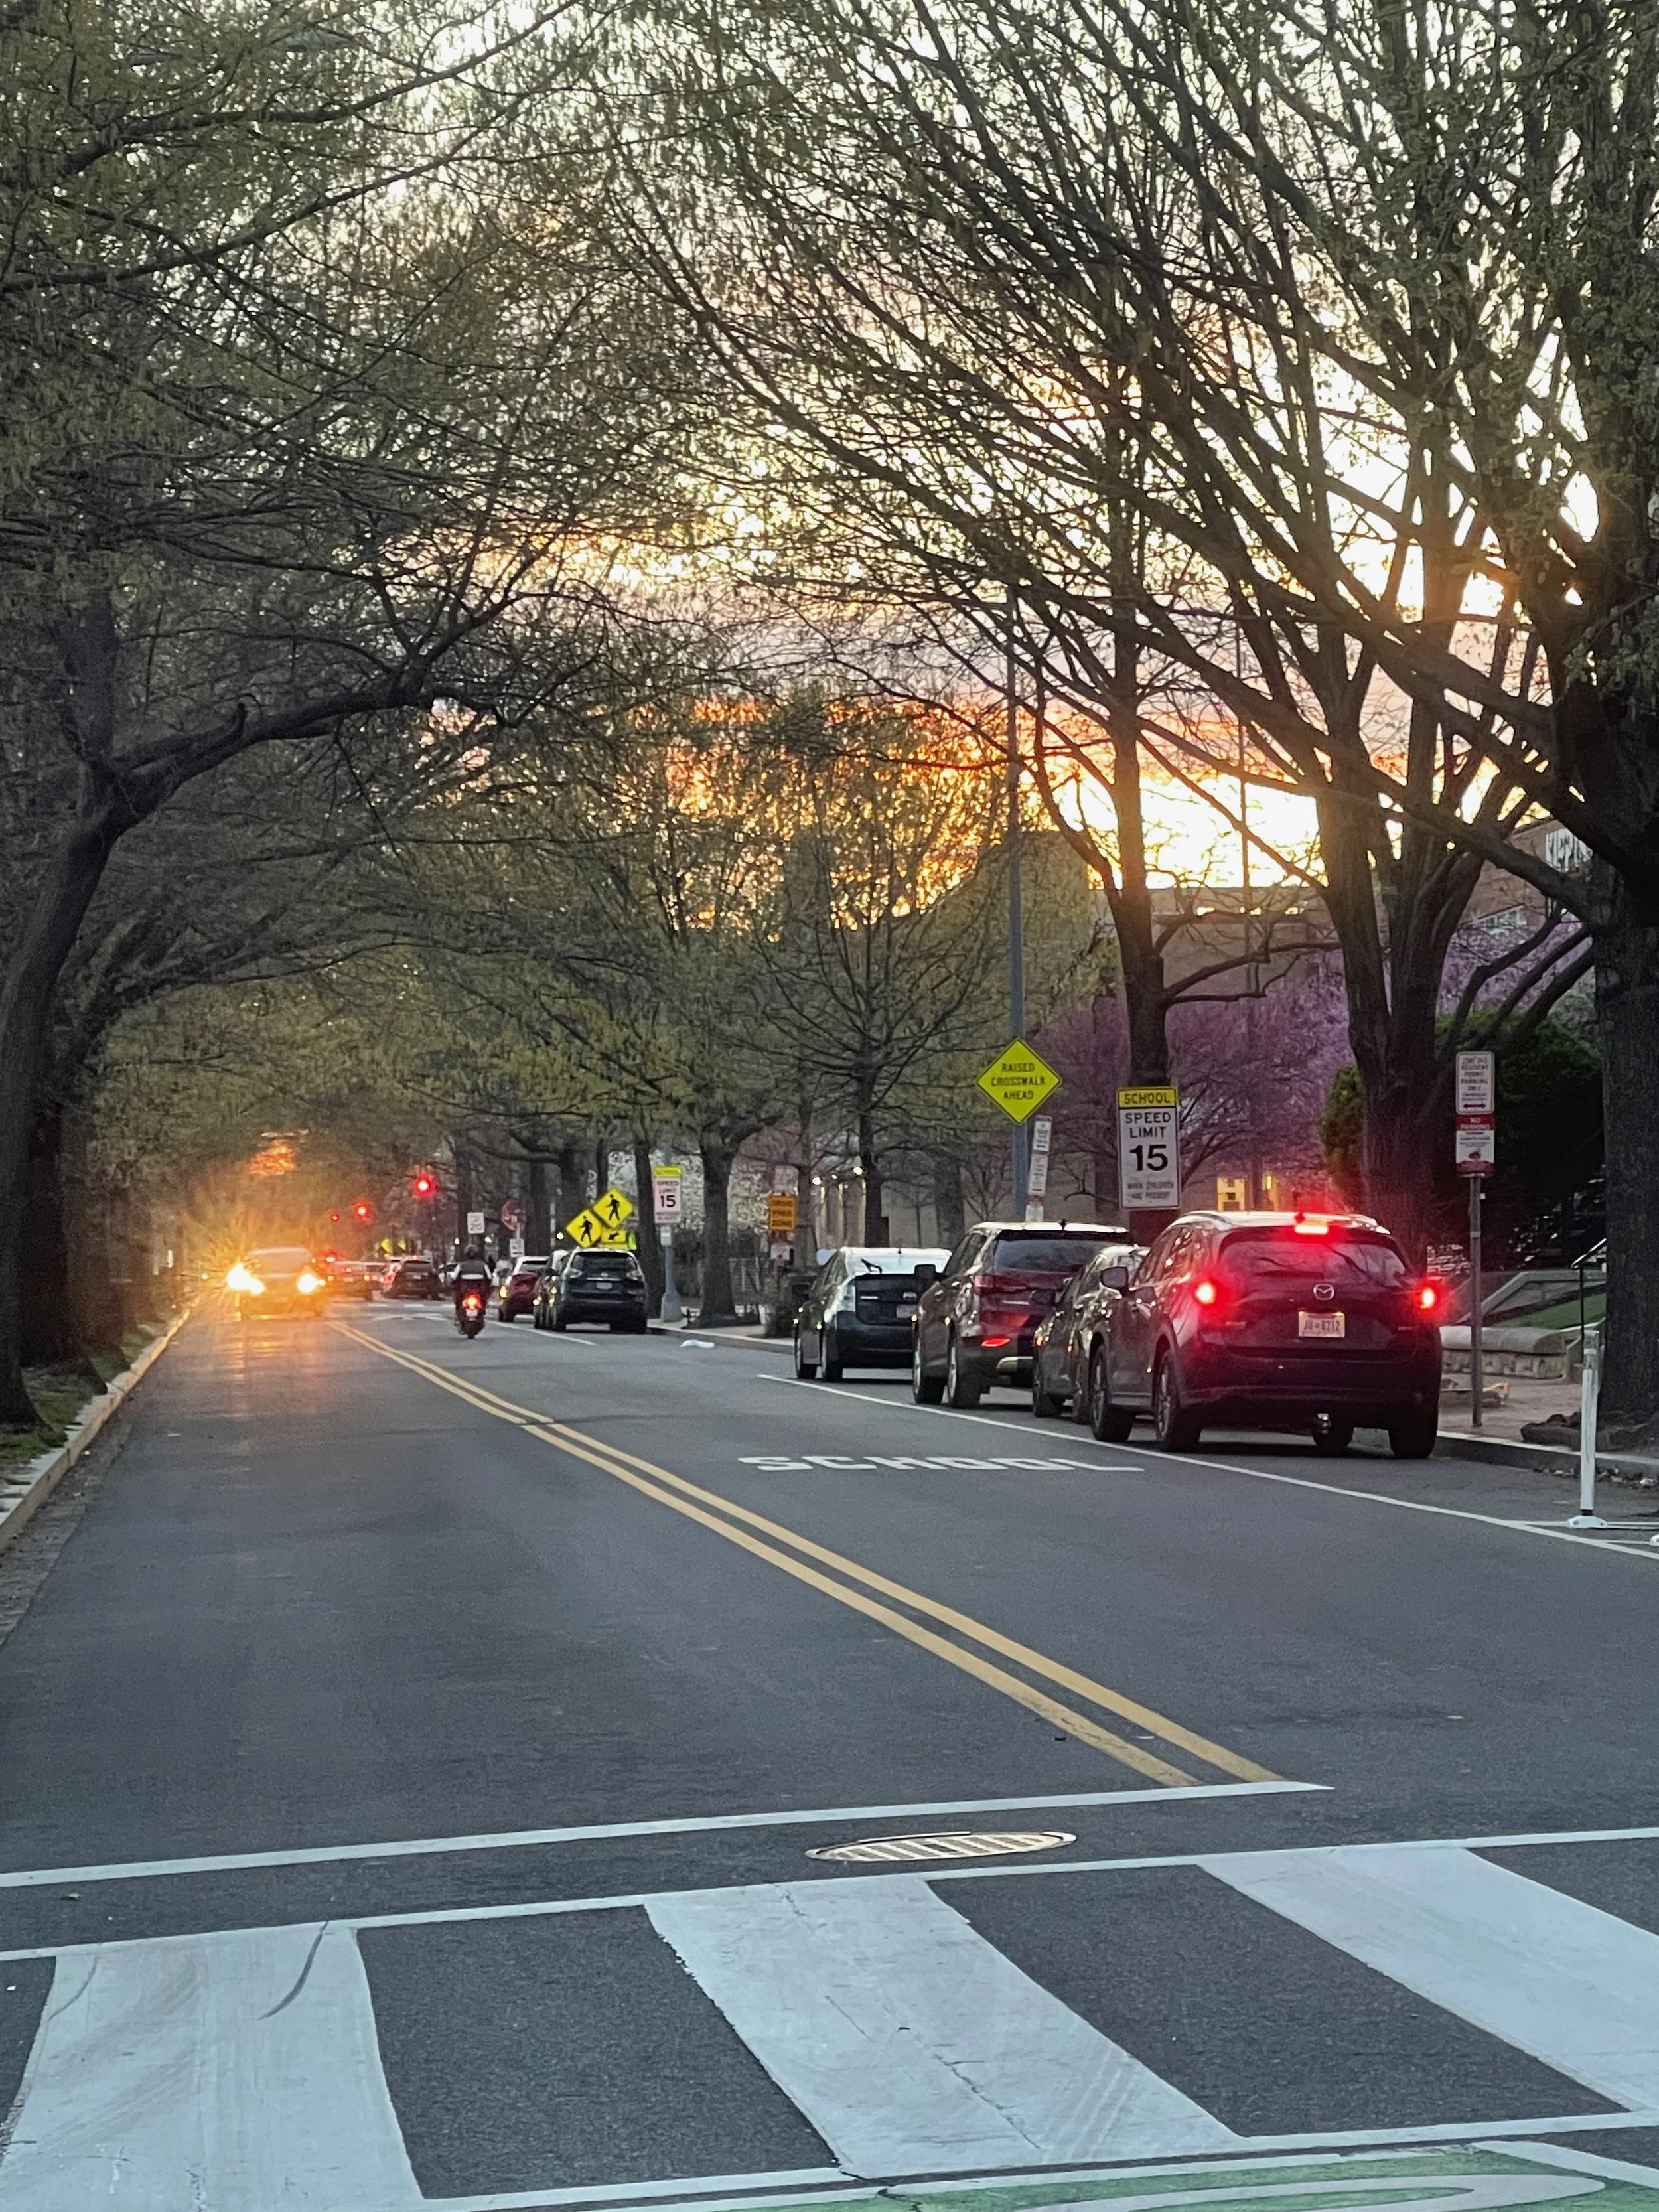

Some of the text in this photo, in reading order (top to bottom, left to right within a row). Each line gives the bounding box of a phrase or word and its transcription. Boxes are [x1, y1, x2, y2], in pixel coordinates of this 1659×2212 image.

[1001, 1063, 1035, 1072] RAISED
[991, 1076, 1046, 1086] CROSSWALK
[1003, 1090, 1033, 1100] AHEAD
[1124, 1092, 1171, 1104] SCHOOL
[1125, 1112, 1171, 1124] SPEED
[1129, 1126, 1166, 1138] LIMIT
[1129, 1144, 1168, 1171] 15
[660, 1195, 676, 1207] 15
[737, 1456, 1145, 1471] SCHOOL
